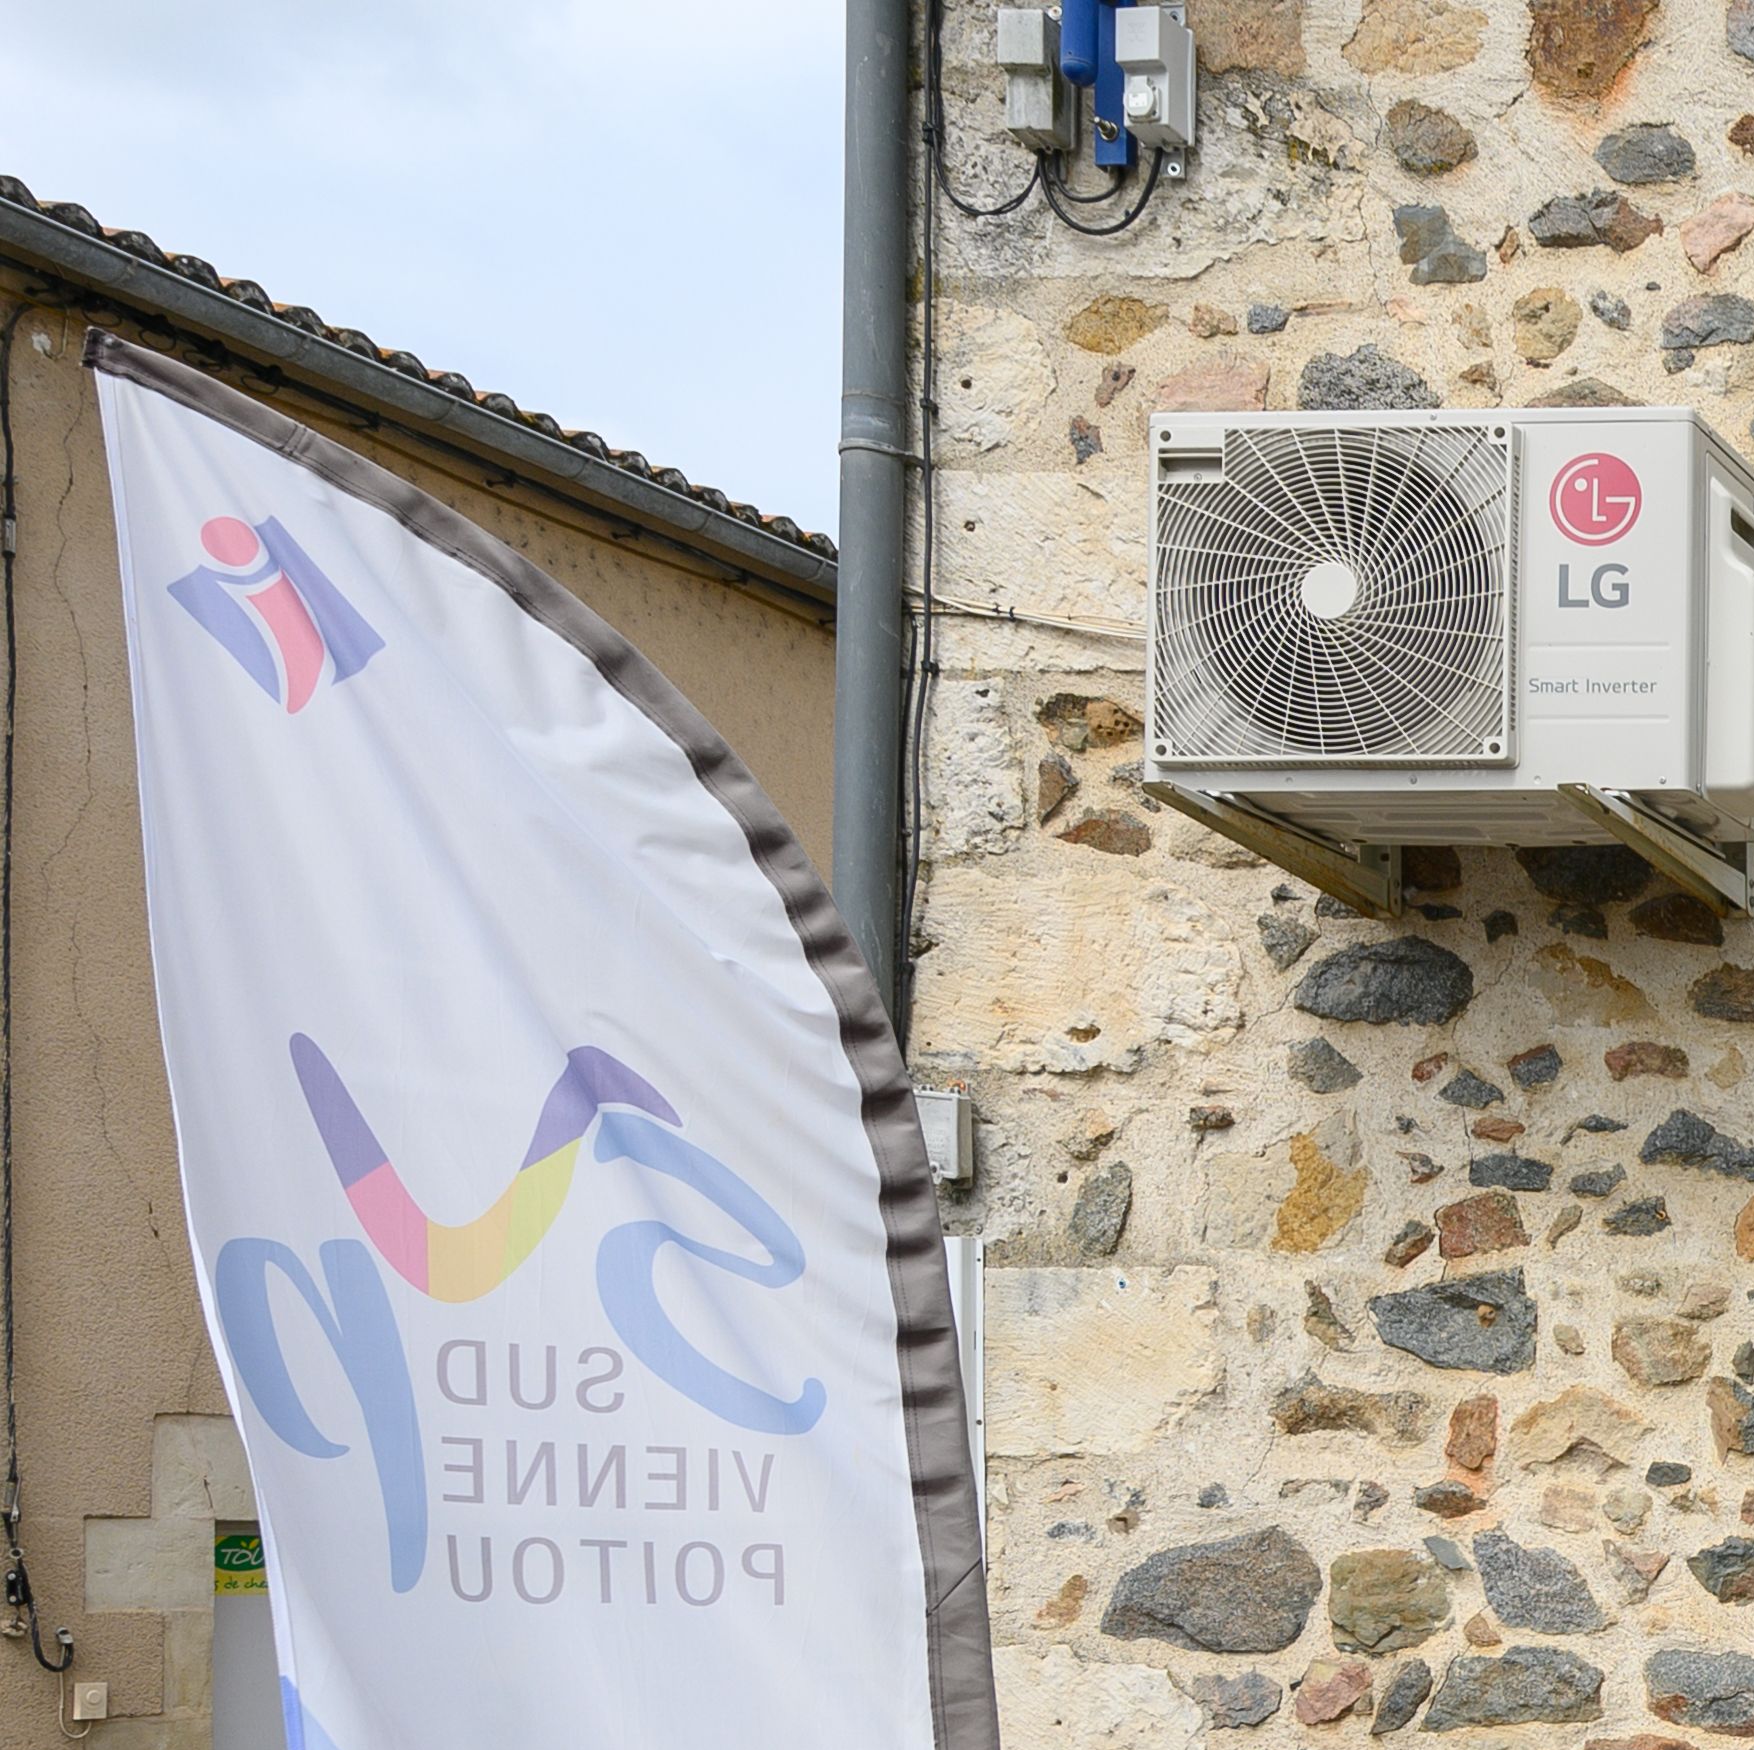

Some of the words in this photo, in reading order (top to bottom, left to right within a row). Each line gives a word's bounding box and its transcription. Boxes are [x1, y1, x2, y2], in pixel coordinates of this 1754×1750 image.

[1556, 563, 1631, 609] LG
[1528, 676, 1580, 695] Smart
[1585, 676, 1658, 695] Inverter
[224, 1576, 239, 1589] de
